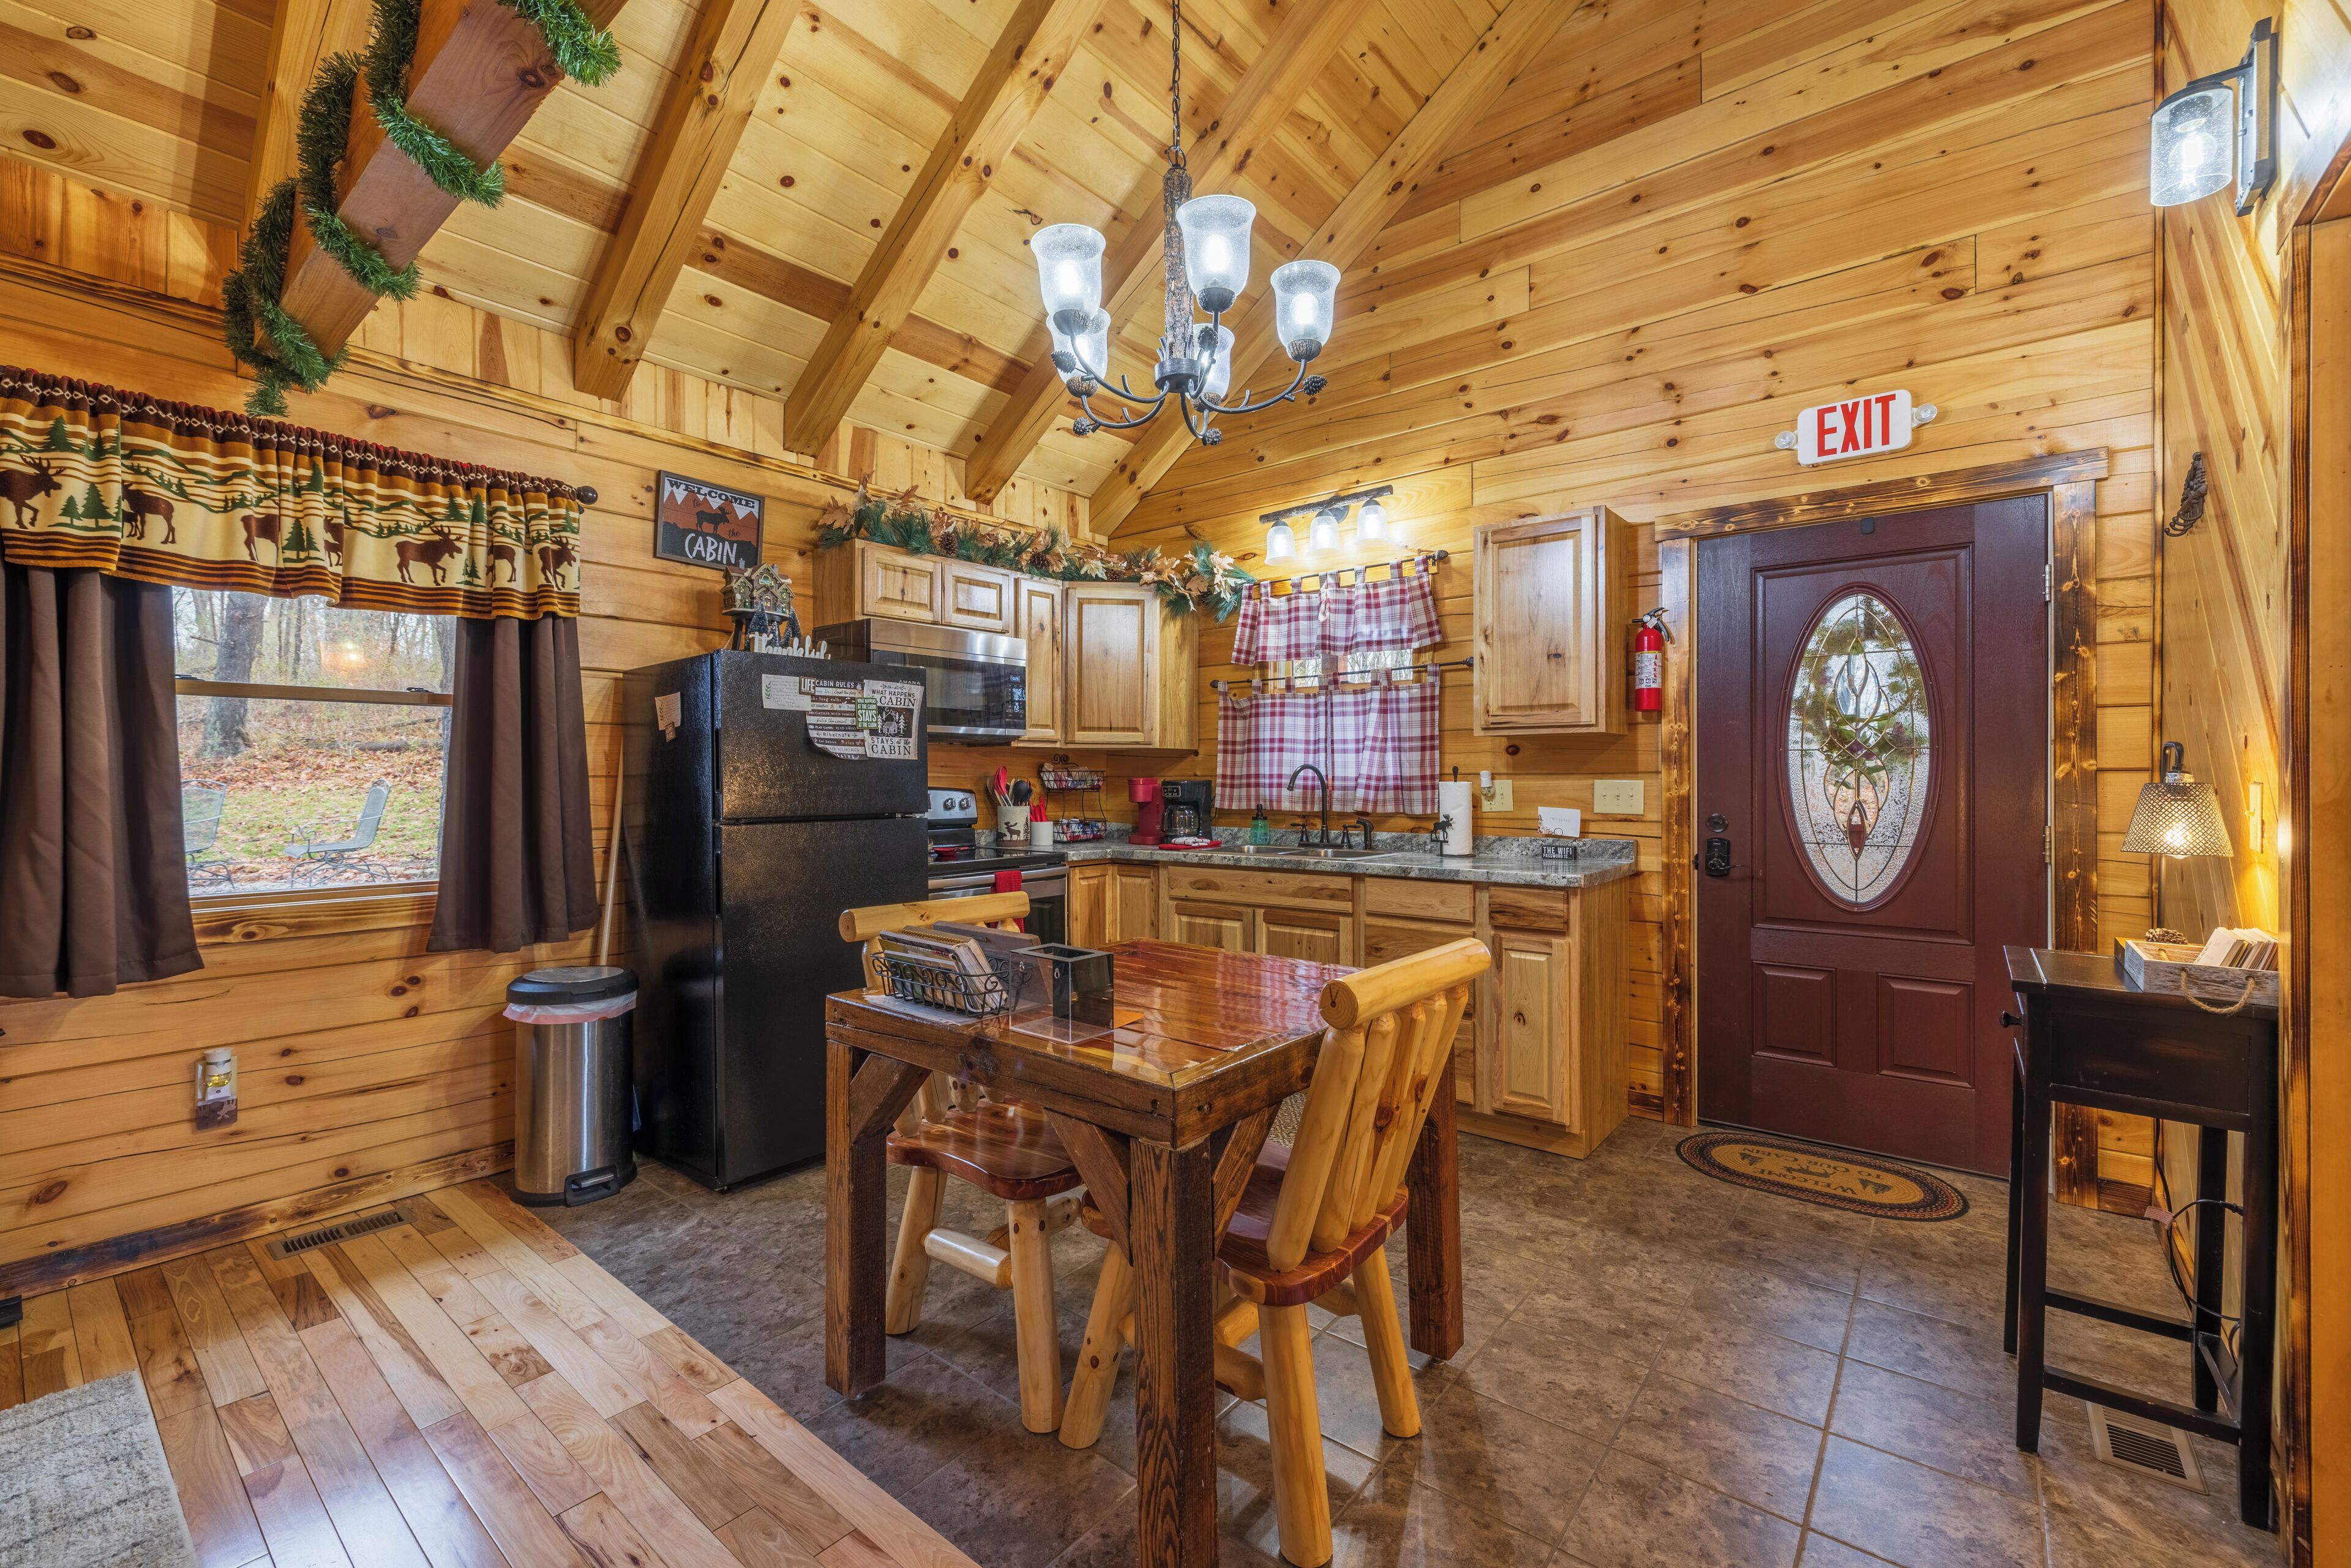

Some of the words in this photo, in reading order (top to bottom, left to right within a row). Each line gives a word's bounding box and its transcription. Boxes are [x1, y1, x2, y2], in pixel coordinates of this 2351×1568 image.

[1817, 394, 1896, 457] EXIT
[667, 478, 755, 509] WELCOME
[692, 498, 701, 508] to
[727, 528, 741, 538] the
[684, 533, 738, 565] CABIN
[801, 678, 815, 691] LIFE
[879, 696, 916, 707] CABIN
[858, 710, 877, 722] STAYS
[871, 745, 911, 755] CABIN
[1742, 1146, 1799, 1163] CABIN
[1807, 1160, 1850, 1174] OUR
[1752, 1166, 1859, 1196] WELCOME
[1857, 1170, 1885, 1180] TO
